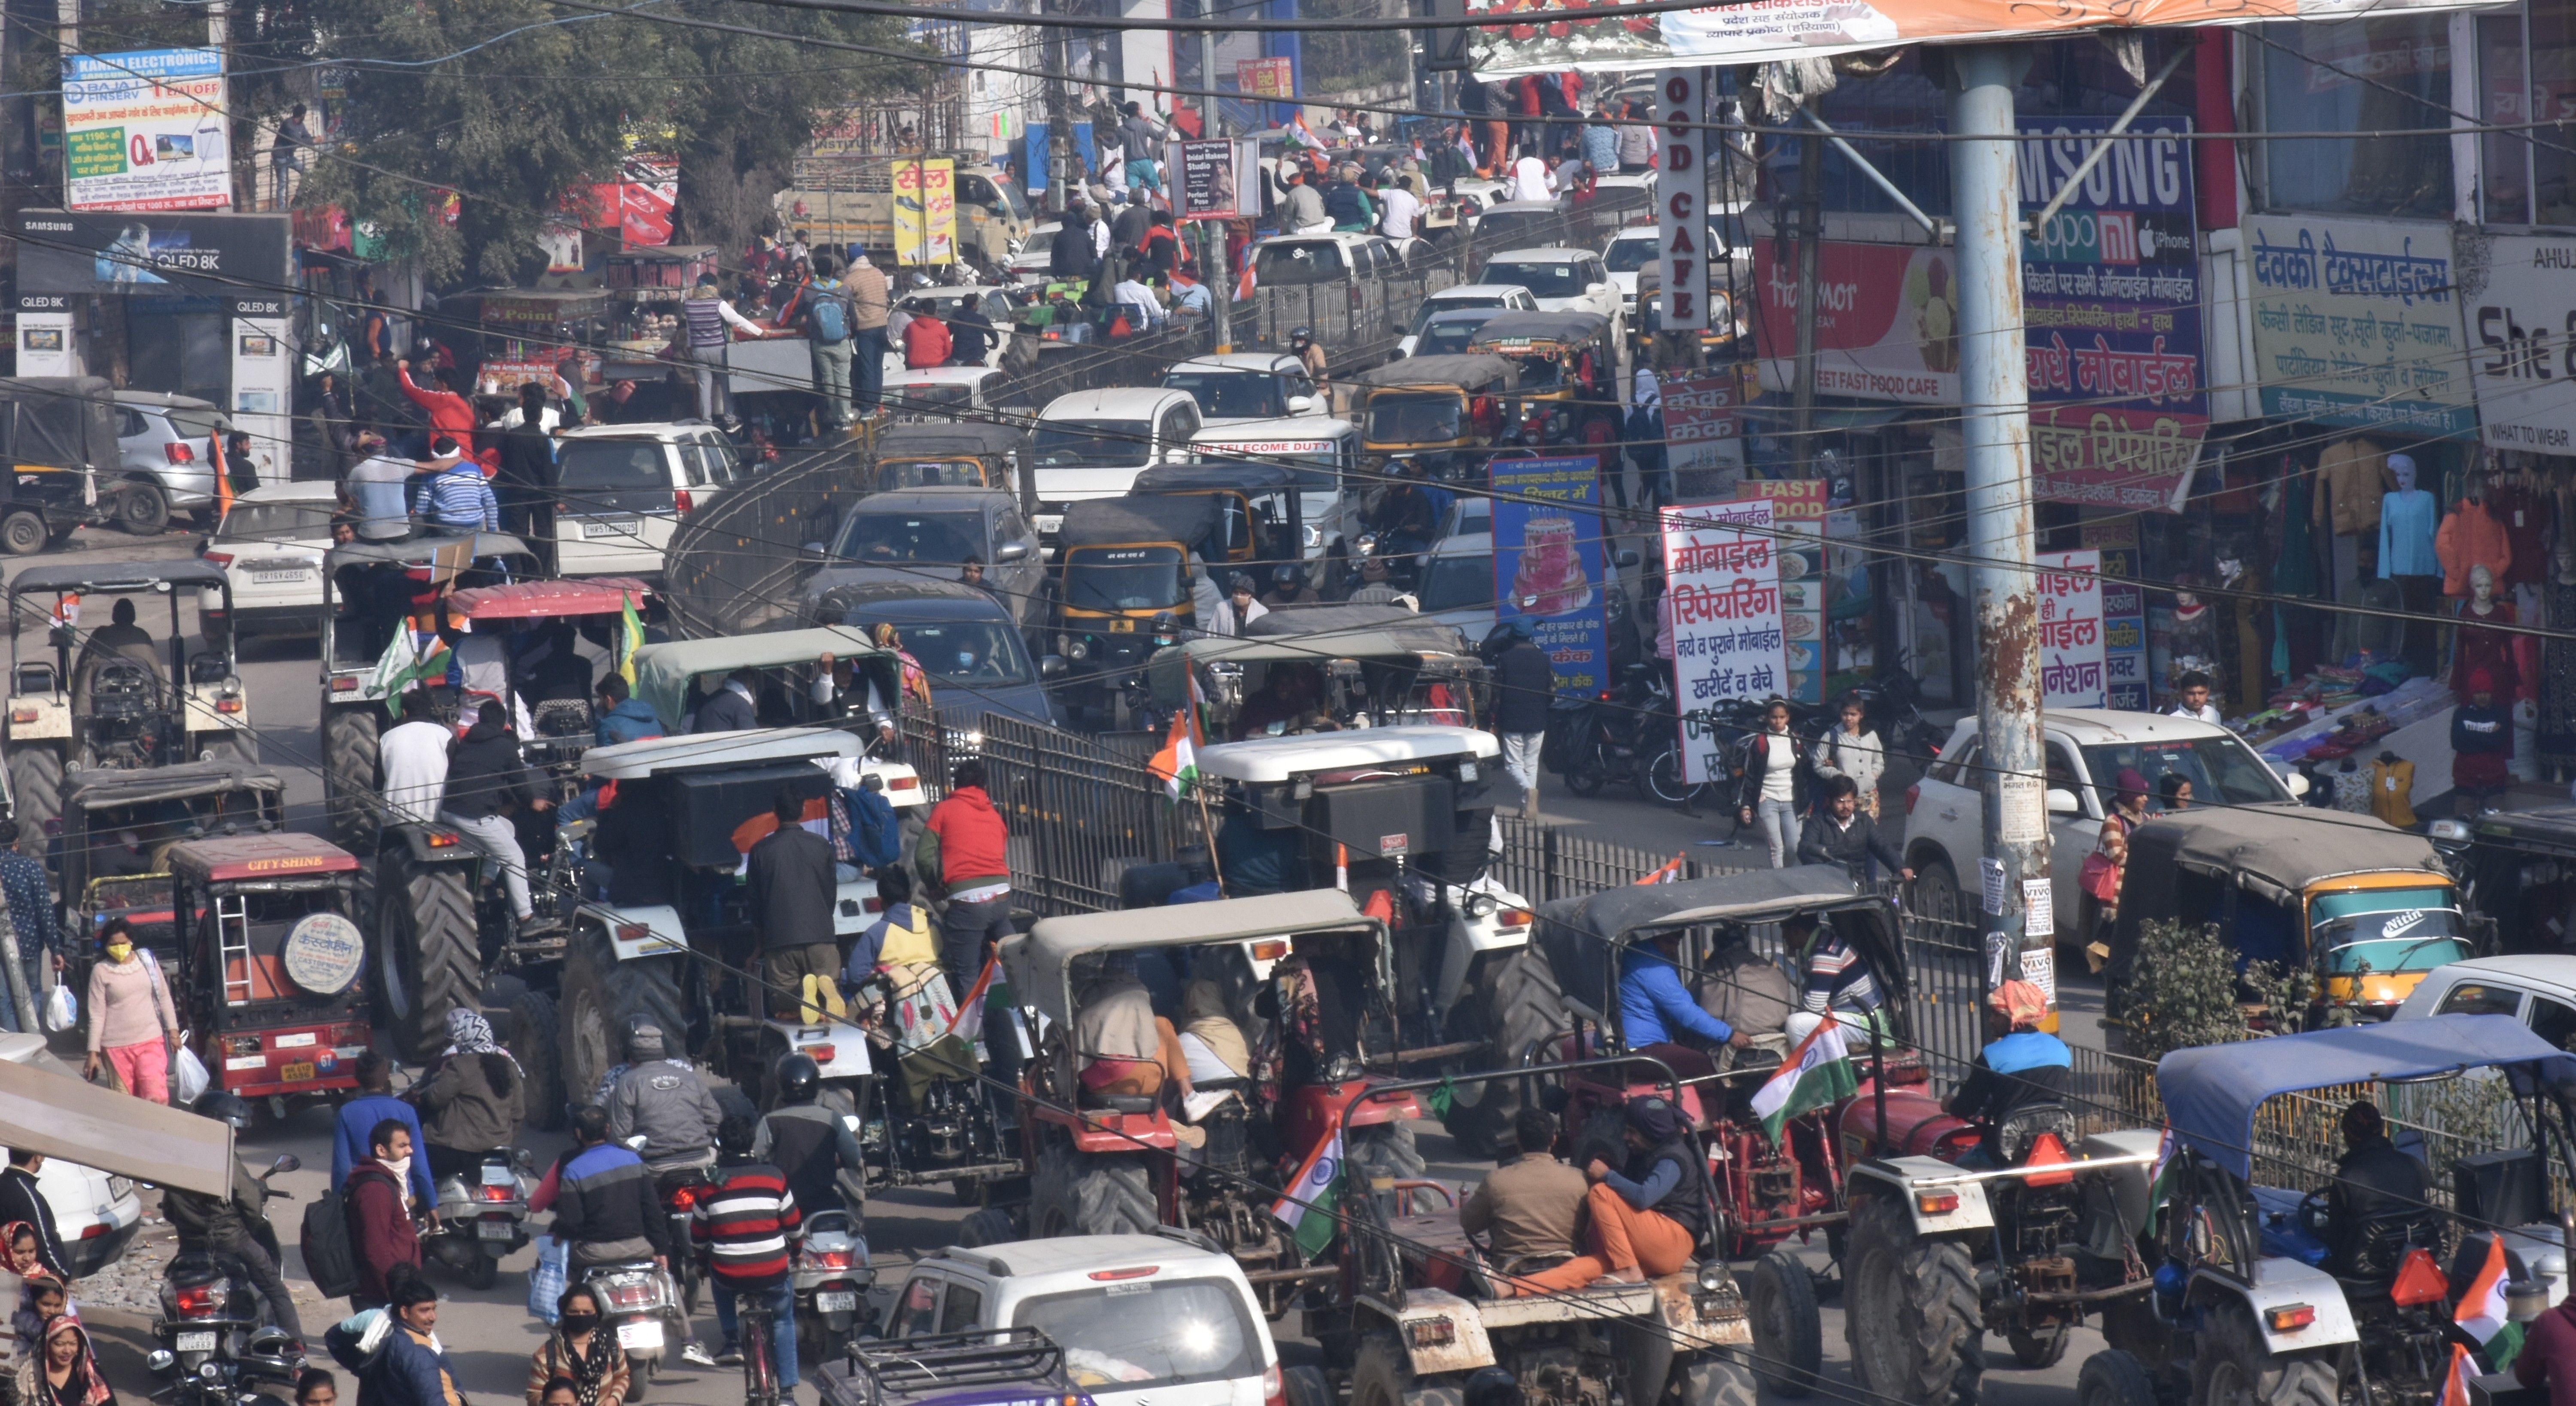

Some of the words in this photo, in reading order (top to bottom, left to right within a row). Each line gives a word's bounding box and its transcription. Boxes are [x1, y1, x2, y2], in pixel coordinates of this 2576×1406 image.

[1722, 15, 1749, 26] प्रदेश
[1752, 15, 1770, 23] सह
[1774, 10, 1821, 22] संयोजक
[1706, 27, 1743, 38] व्यापार
[1787, 21, 1841, 33] (हरियाणा)
[128, 52, 217, 69] ELECTRONICS
[88, 81, 140, 92] BAJAJ
[194, 83, 217, 95] OFF
[88, 90, 139, 102] FINSERV
[1666, 76, 1692, 171] OOD
[130, 134, 155, 167] 0%
[896, 162, 950, 189] सेल
[1187, 162, 1211, 171] Studio
[2016, 127, 2181, 206] MSUNG
[25, 221, 73, 231] SAMSUNG
[2031, 215, 2097, 259] ppo
[2154, 228, 2190, 249] iPhone
[157, 255, 197, 270] QLED
[200, 255, 219, 270] 8K
[1670, 191, 1695, 319] CAFE
[2252, 227, 2318, 289] देवकी
[2058, 272, 2073, 295] पर
[2075, 264, 2097, 296] सभी
[2151, 267, 2194, 302] मोबाईल
[21, 297, 49, 308] QLED
[50, 297, 64, 308] 8K
[237, 302, 264, 313] QLED
[266, 302, 278, 313] 8K
[504, 309, 554, 321] Point
[2477, 306, 2552, 380] She
[2025, 331, 2072, 393] राधे
[2074, 332, 2198, 406] मोबाईल
[1840, 370, 1869, 391] FAST
[1870, 374, 1906, 394] FOOD
[1907, 377, 1939, 397] CAFE
[1664, 385, 1733, 412] केक
[1668, 415, 1742, 440] केक
[2490, 423, 2521, 443] WHAT
[2521, 426, 2535, 443] TO
[2538, 427, 2569, 446] WEAR
[1218, 443, 1290, 453] TELECOME
[1293, 442, 1331, 451] DUTY
[1571, 484, 1590, 500] में
[1760, 481, 1822, 497] FAST
[1716, 504, 1771, 526] मोबाईल
[1775, 501, 1825, 518] OOD
[1672, 528, 1771, 574] मोबाईल
[1673, 577, 1777, 625] रिपेयरिंग
[2041, 597, 2056, 621] ही
[1676, 631, 1695, 658] नये
[1697, 637, 1707, 656] व
[1707, 626, 1736, 666] पुराने
[1737, 621, 1781, 653] मोबाईल
[1550, 645, 1594, 664] केक
[1691, 667, 1734, 699] खरीदें
[1735, 674, 1747, 693] व
[1749, 663, 1774, 691] बेचे
[248, 859, 279, 871] CITY
[281, 855, 323, 868] SHINE
[2025, 887, 2050, 896] VIVO
[2385, 908, 2424, 932] Nitin
[2023, 957, 2051, 969] VIVO
[320, 1054, 332, 1067] 67
